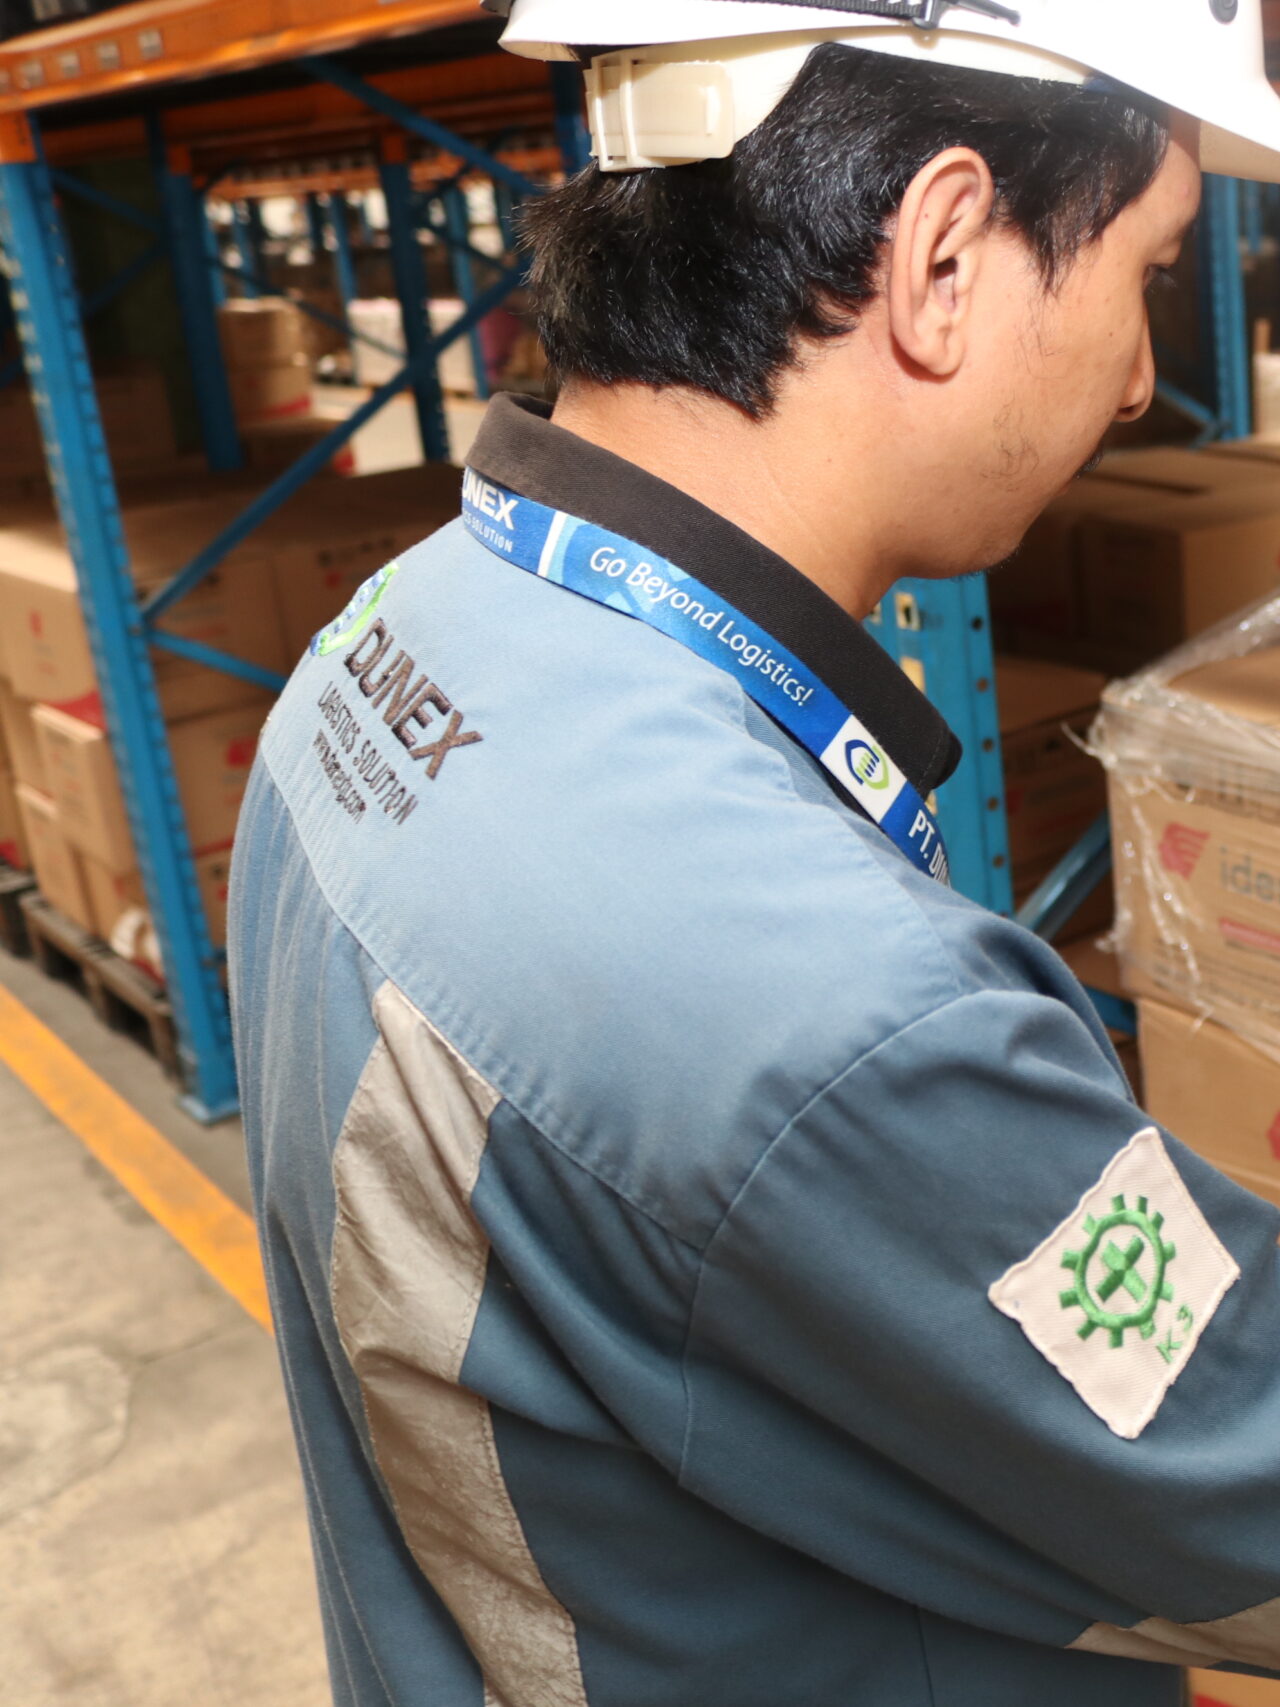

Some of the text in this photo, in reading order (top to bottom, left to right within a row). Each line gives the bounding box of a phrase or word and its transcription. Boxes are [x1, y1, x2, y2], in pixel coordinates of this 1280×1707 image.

[462, 466, 519, 531] UNEX
[589, 546, 815, 707] Go Beyond Logistics!
[343, 616, 485, 782] DUNEX
[907, 808, 936, 860] PT.
